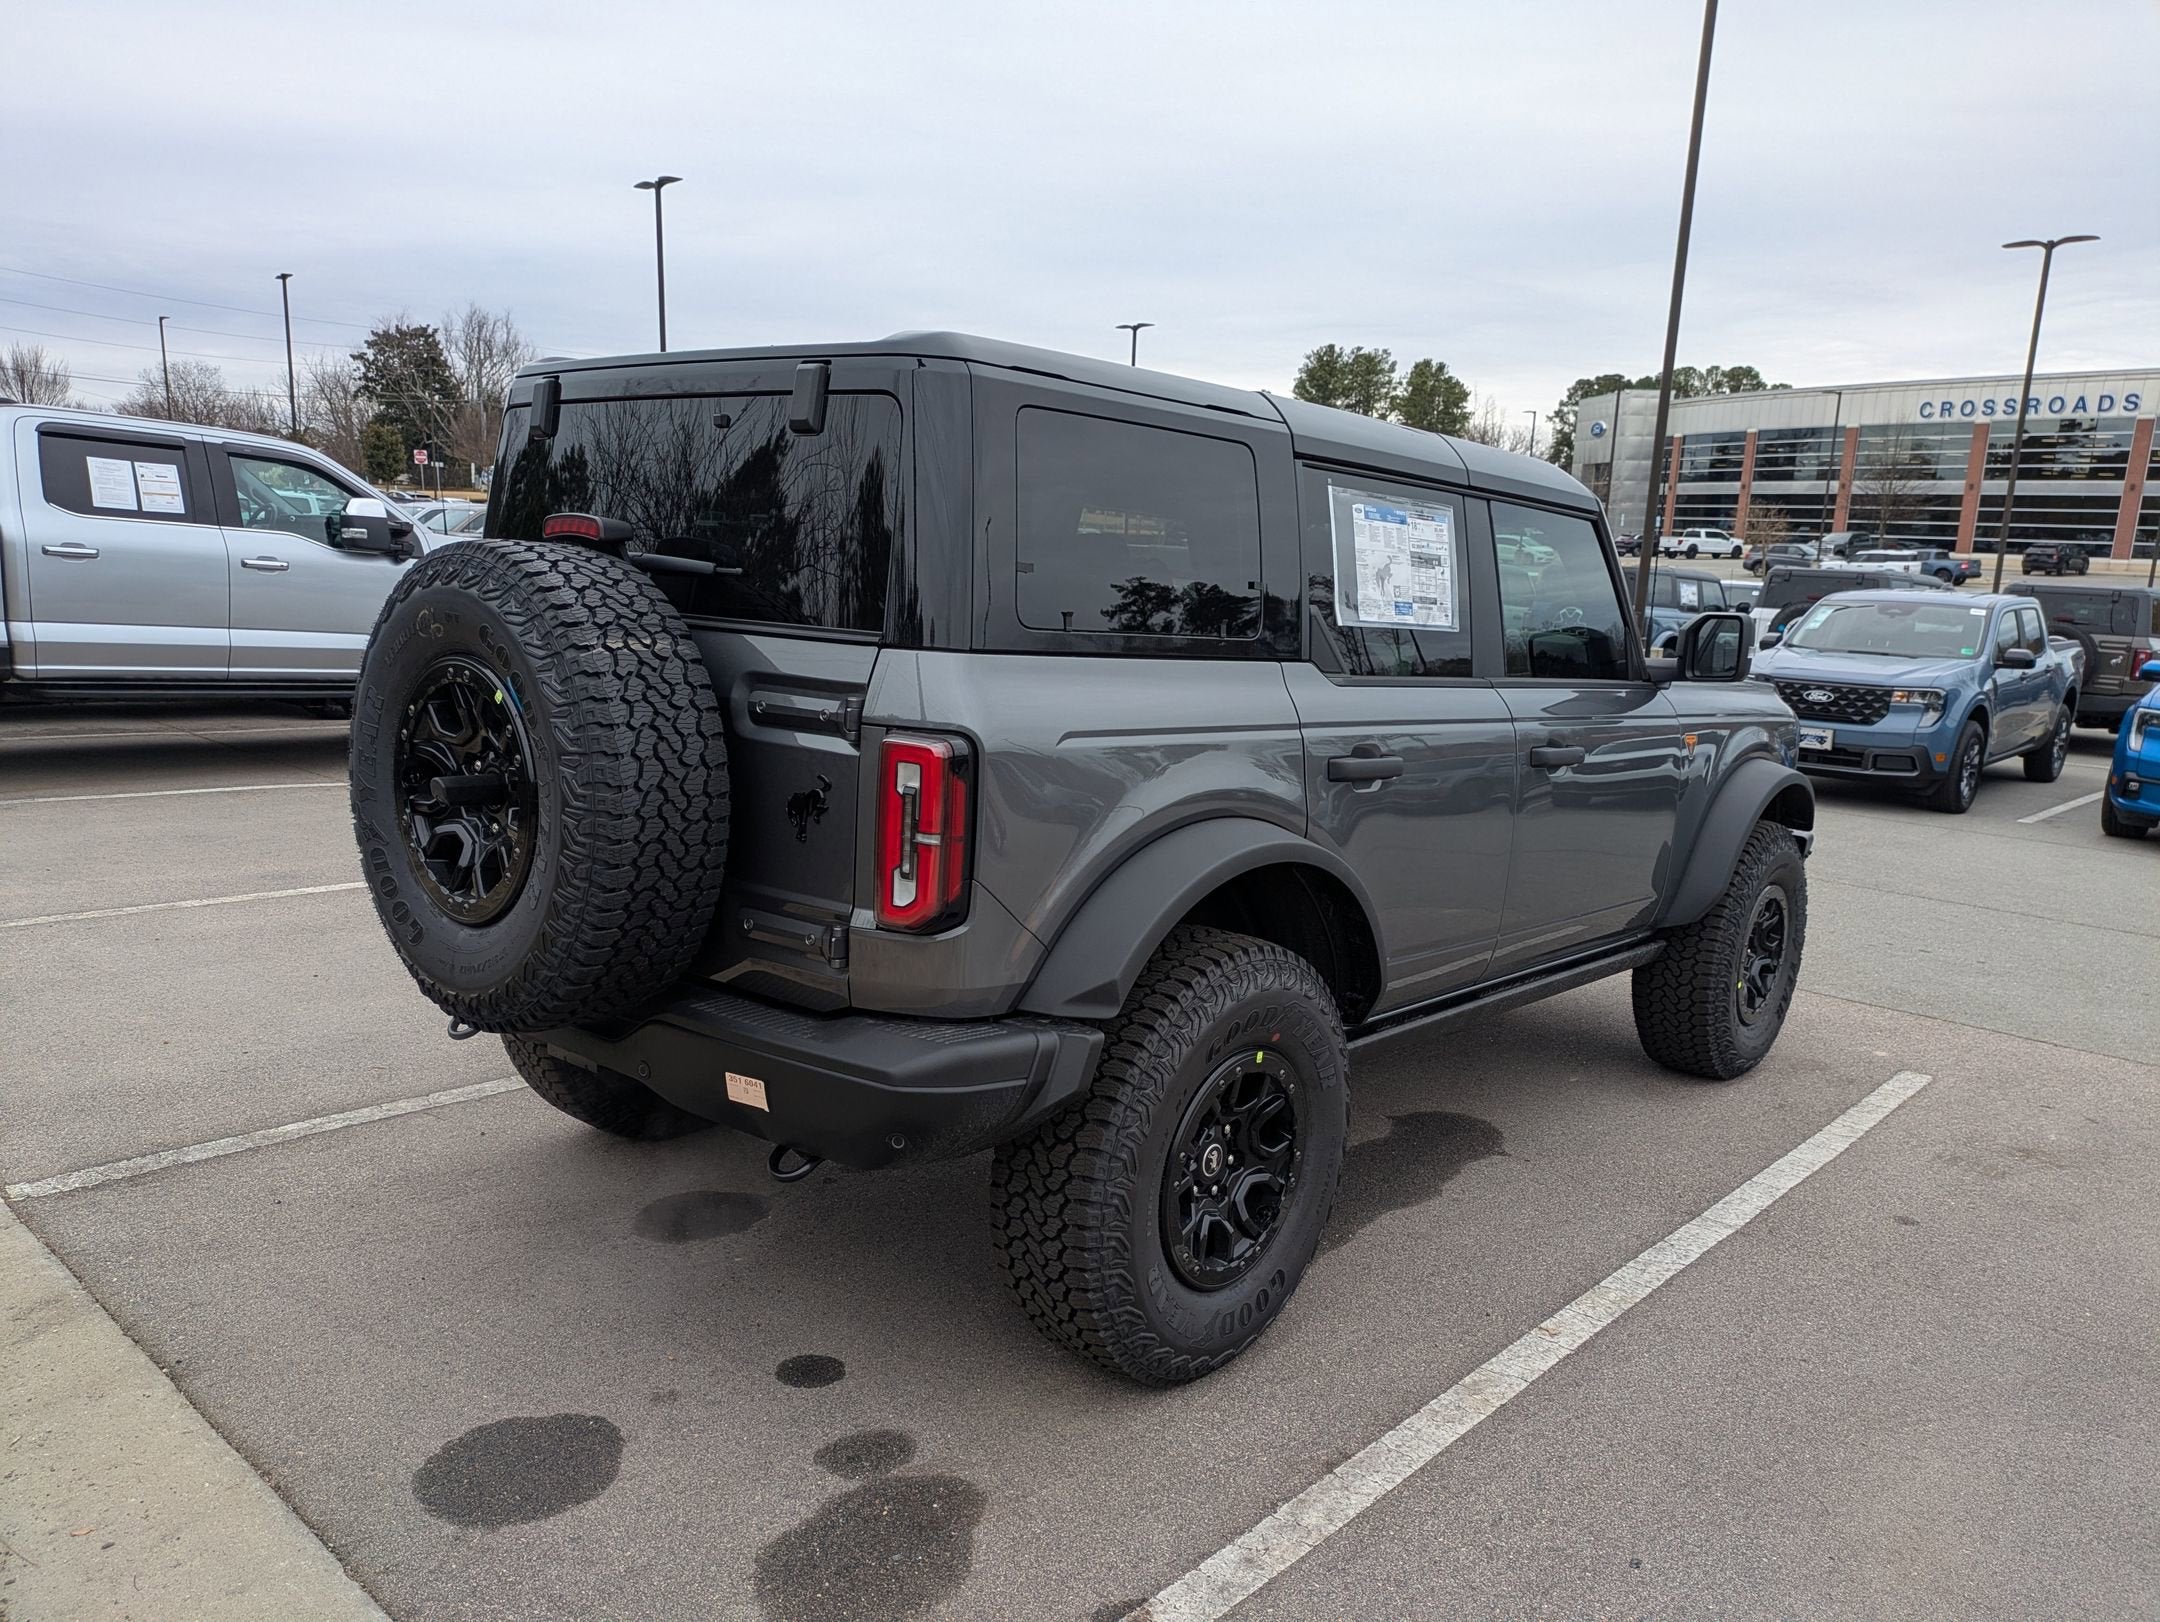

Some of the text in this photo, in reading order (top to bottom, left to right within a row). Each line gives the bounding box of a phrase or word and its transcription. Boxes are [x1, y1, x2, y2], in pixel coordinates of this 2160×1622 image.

[1919, 393, 2141, 420] CROSSROADS
[355, 684, 424, 947] GOODYEAR
[1206, 1003, 1337, 1092] GOODYEAR
[1147, 1262, 1286, 1348] GOODYEAR
